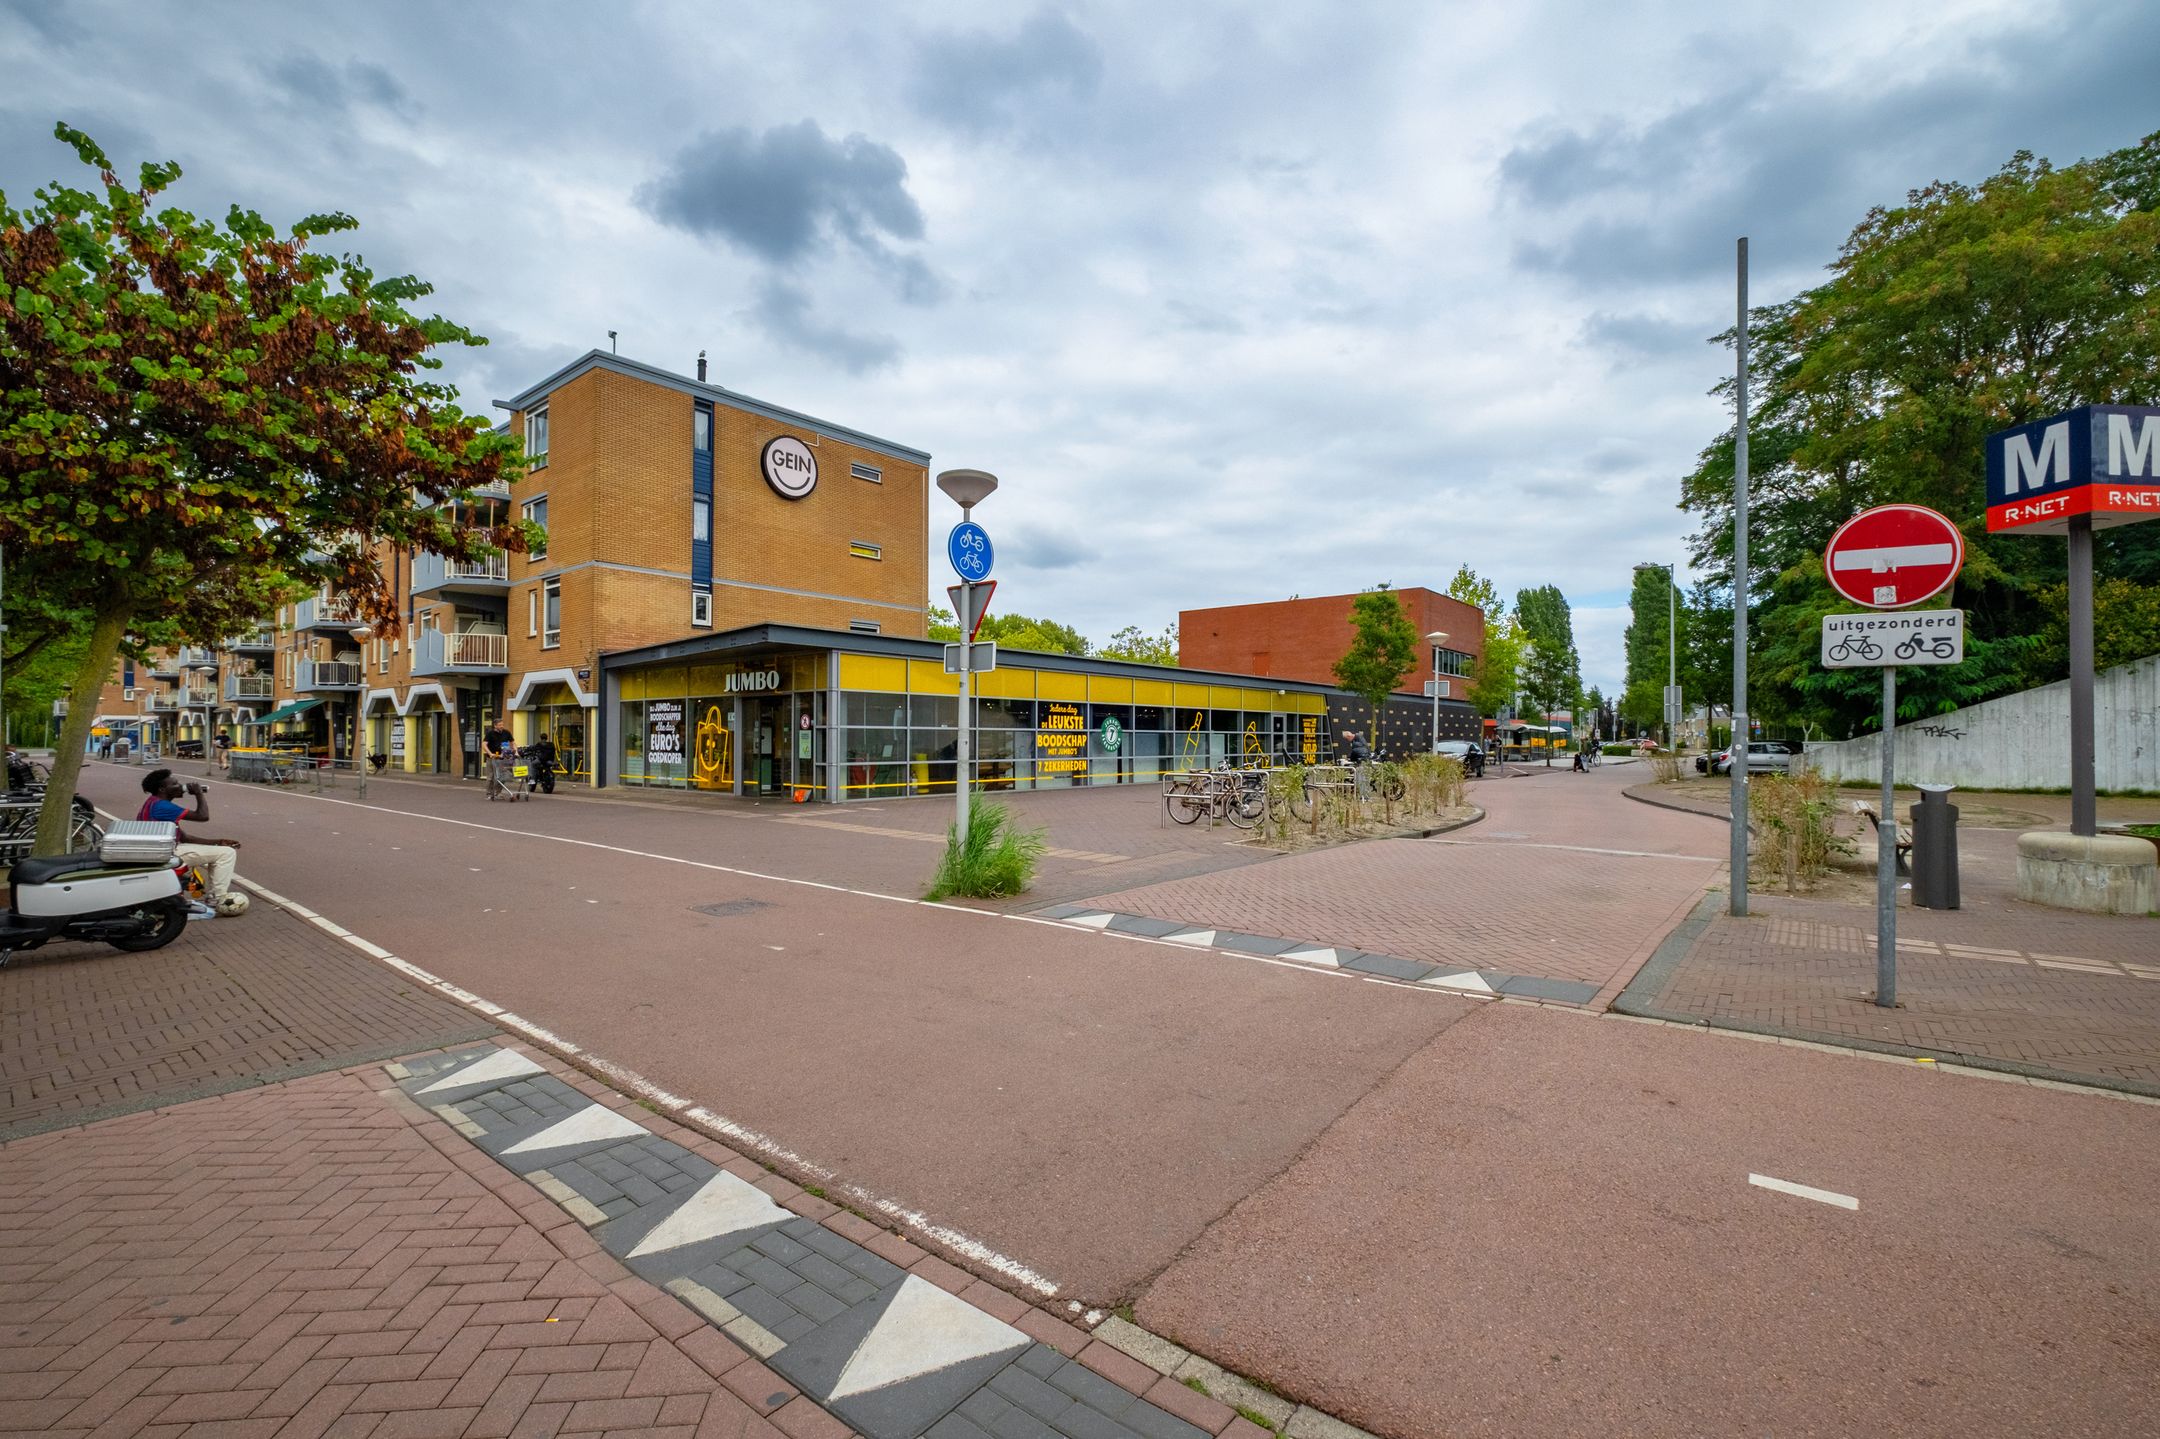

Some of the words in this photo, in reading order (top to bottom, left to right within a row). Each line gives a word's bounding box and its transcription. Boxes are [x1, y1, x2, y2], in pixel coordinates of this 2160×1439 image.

[2108, 414, 2160, 477] M
[772, 449, 811, 474] GEIN
[2004, 420, 2070, 496] M
[1829, 616, 1956, 634] uitgezonderd
[724, 671, 780, 692] JUMBO
[655, 703, 670, 711] JUMBO
[650, 713, 681, 721] BOODSCHAPPEN
[1048, 715, 1084, 729] LEUKSTE
[650, 734, 680, 751] EURO'S
[1037, 735, 1087, 747] BOODSCHAP
[648, 752, 682, 764] GOEDKOPER
[1048, 748, 1057, 756] MET
[1038, 761, 1042, 773] 7
[1044, 760, 1087, 773] ZEKERHEDEN
